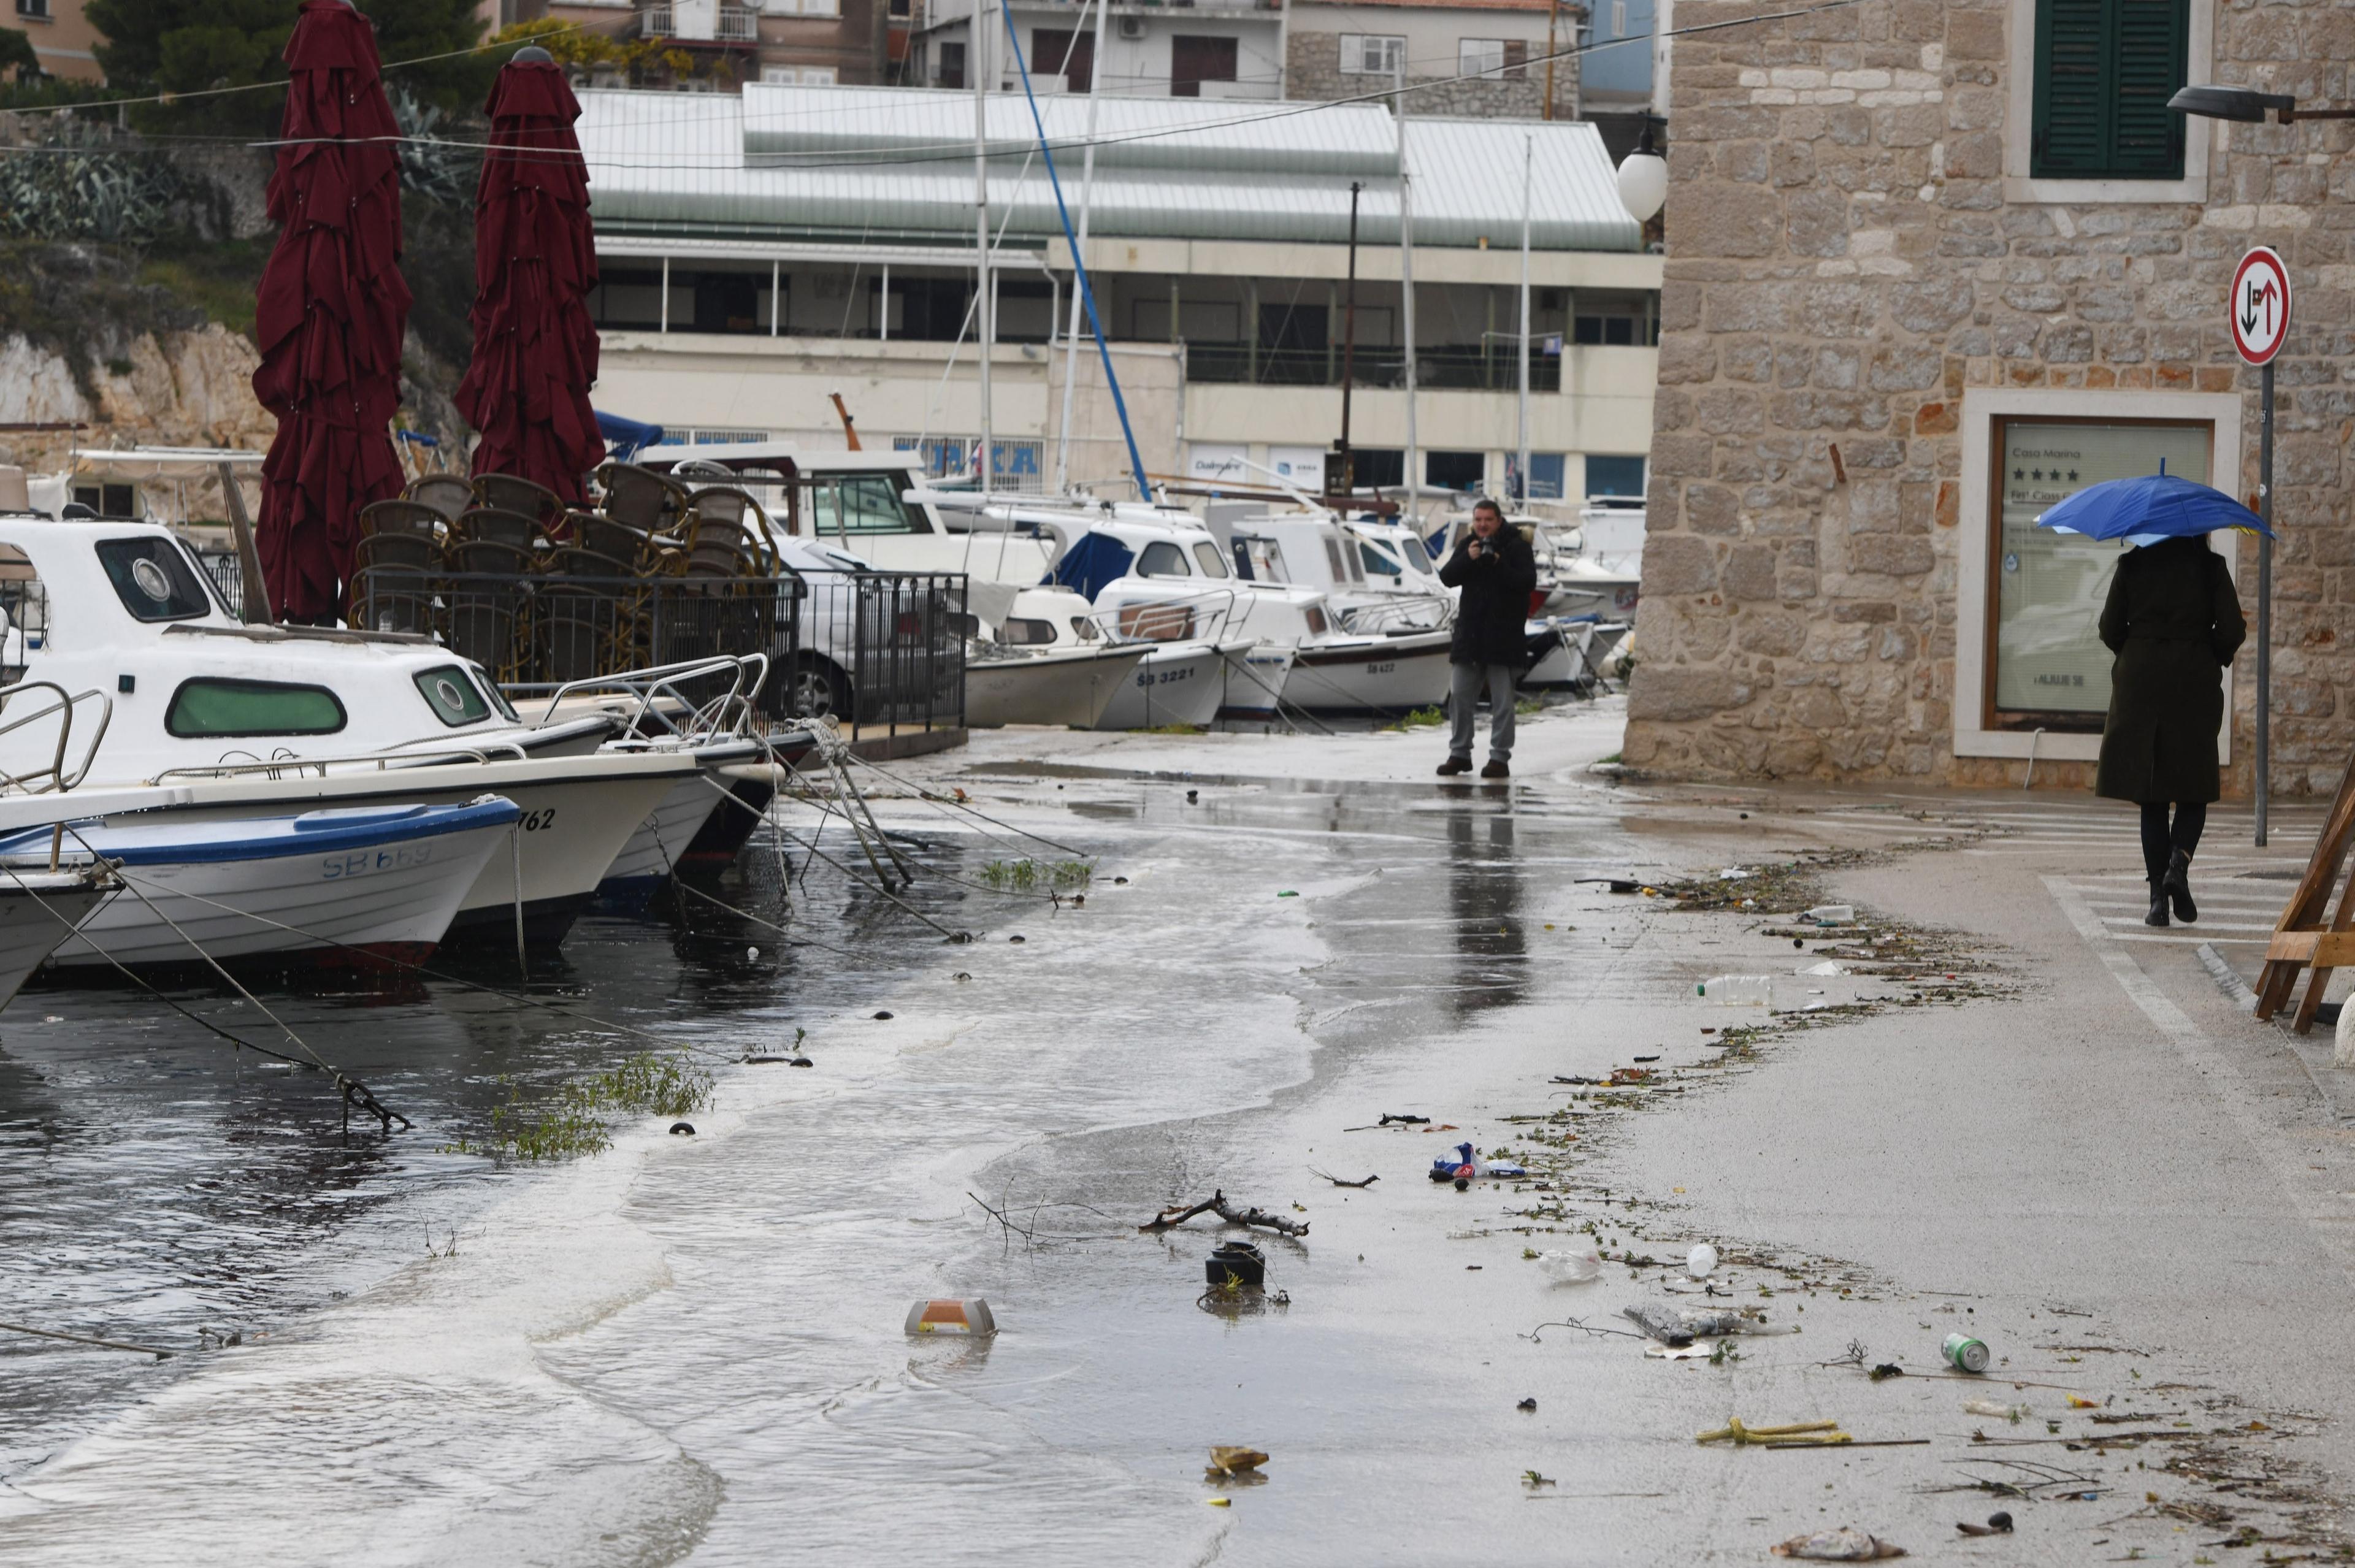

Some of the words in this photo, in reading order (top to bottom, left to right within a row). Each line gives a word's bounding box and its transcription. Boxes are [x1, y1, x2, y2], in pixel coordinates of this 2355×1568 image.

[2012, 447, 2040, 459] Casa
[2043, 449, 2081, 459] Marina
[1159, 666, 1195, 684] 3221
